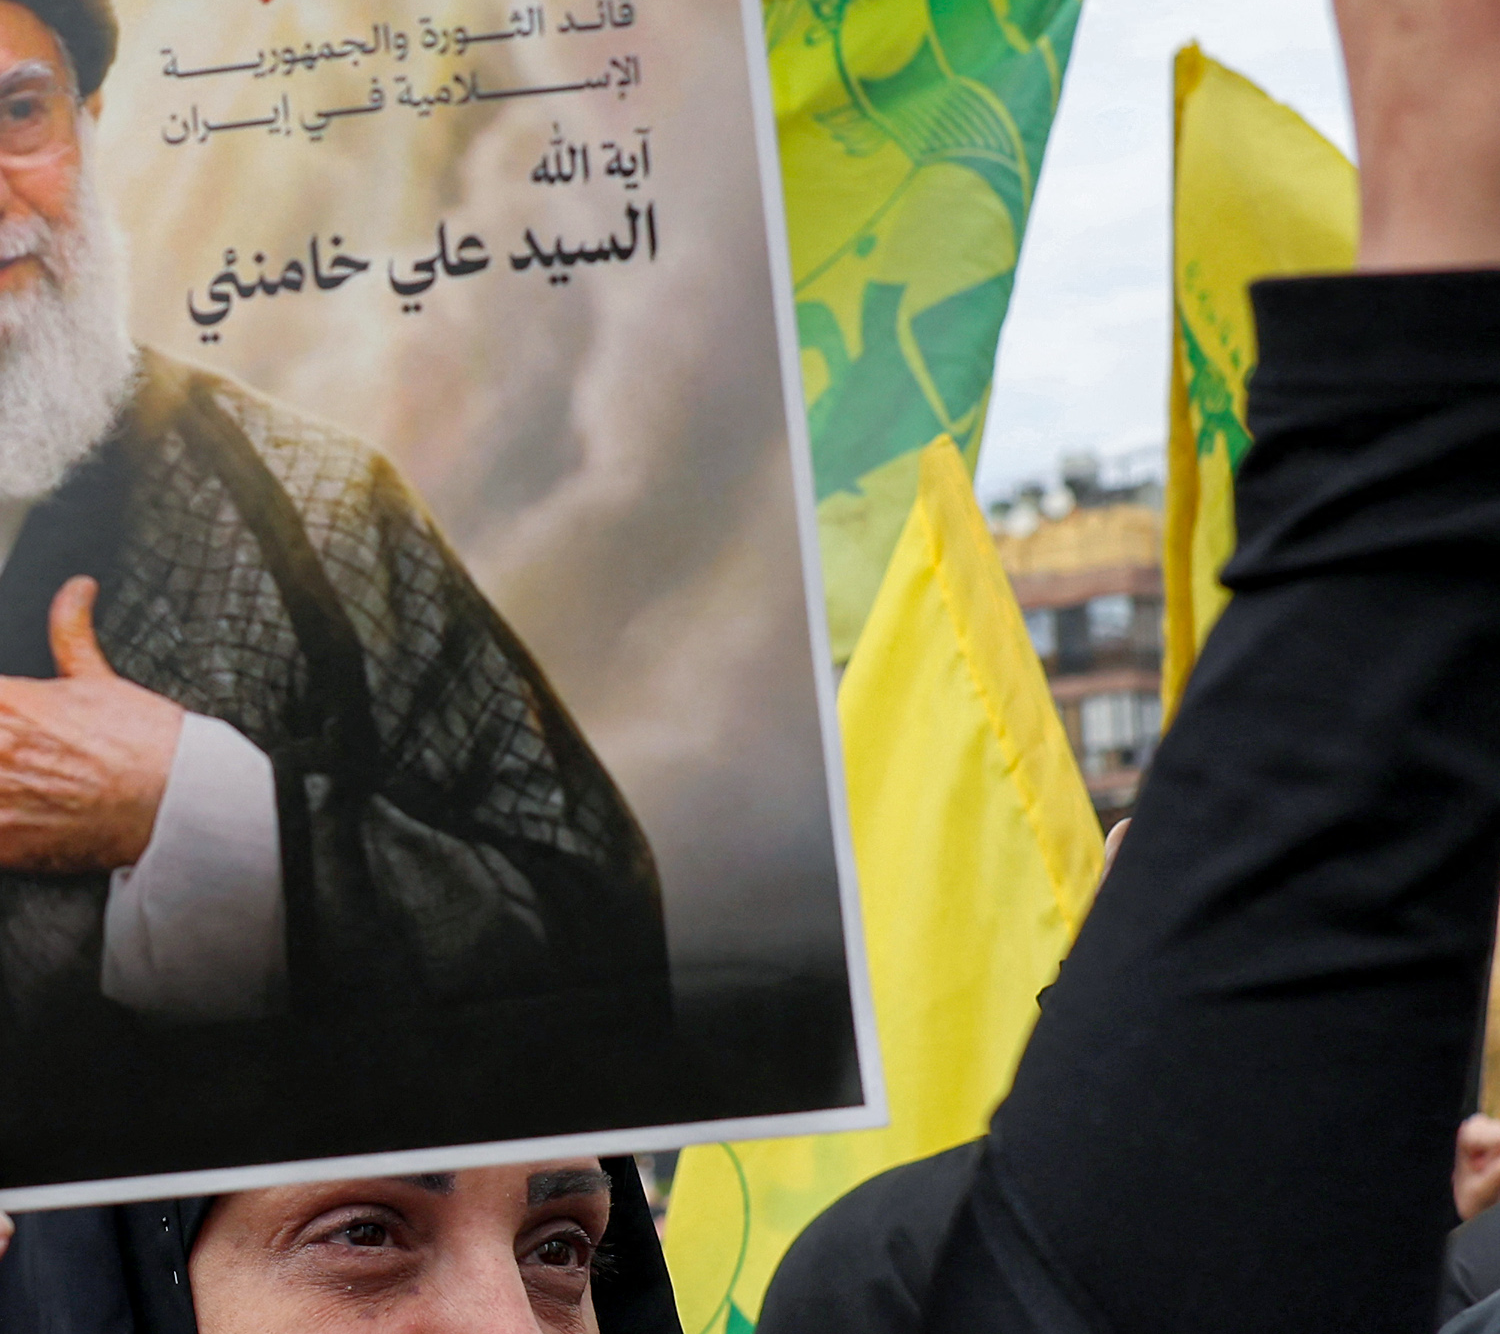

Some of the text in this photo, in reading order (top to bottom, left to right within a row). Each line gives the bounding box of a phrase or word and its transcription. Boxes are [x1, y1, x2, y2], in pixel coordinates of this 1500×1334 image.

[161, 23, 408, 79] والجمهورية
[419, 7, 544, 55] الثورة
[162, 56, 640, 145] الإسلامية في إيران
[530, 122, 651, 190] آية الله
[188, 200, 659, 344] السيد علي خامنئي
